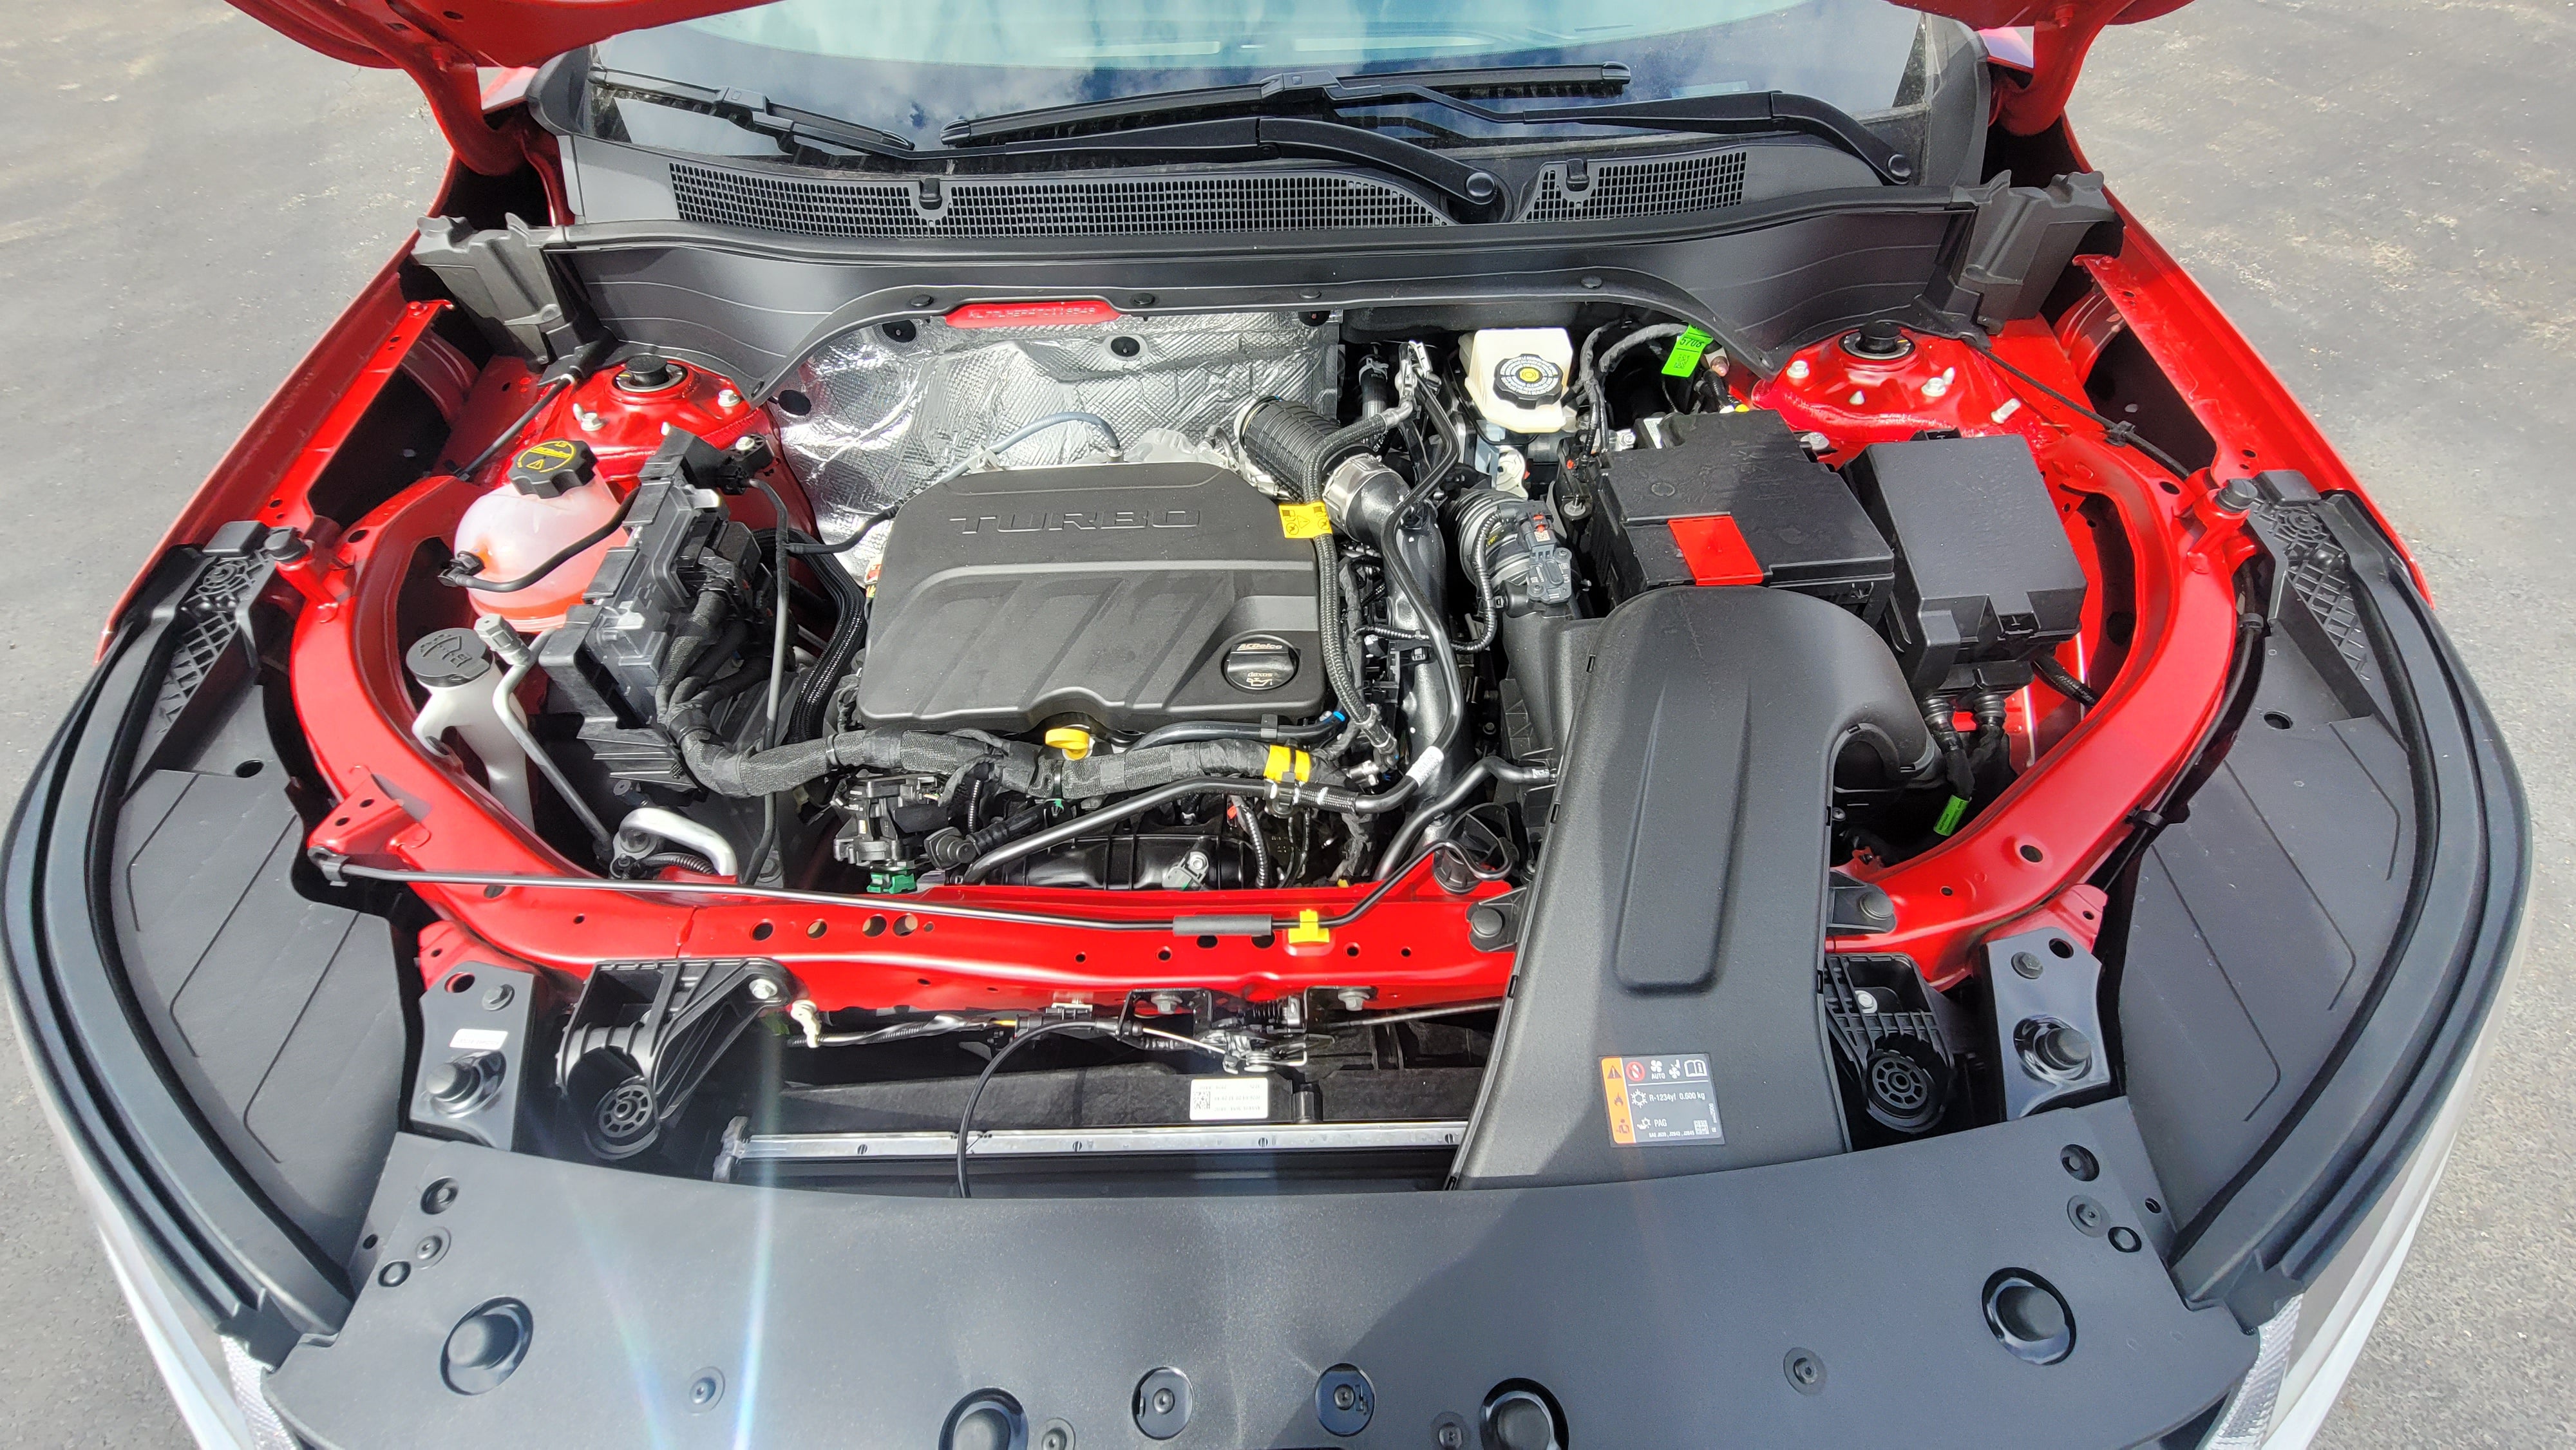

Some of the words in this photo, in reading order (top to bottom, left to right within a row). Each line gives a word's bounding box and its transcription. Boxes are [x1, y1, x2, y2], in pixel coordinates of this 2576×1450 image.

[949, 510, 1201, 534] TURBO
[1236, 643, 1283, 651] ACDelco
[1649, 1093, 1677, 1102] R-1234yf
[1679, 1092, 1696, 1100] 0.600
[1697, 1091, 1706, 1100] kg
[1654, 1118, 1667, 1127] PAG
